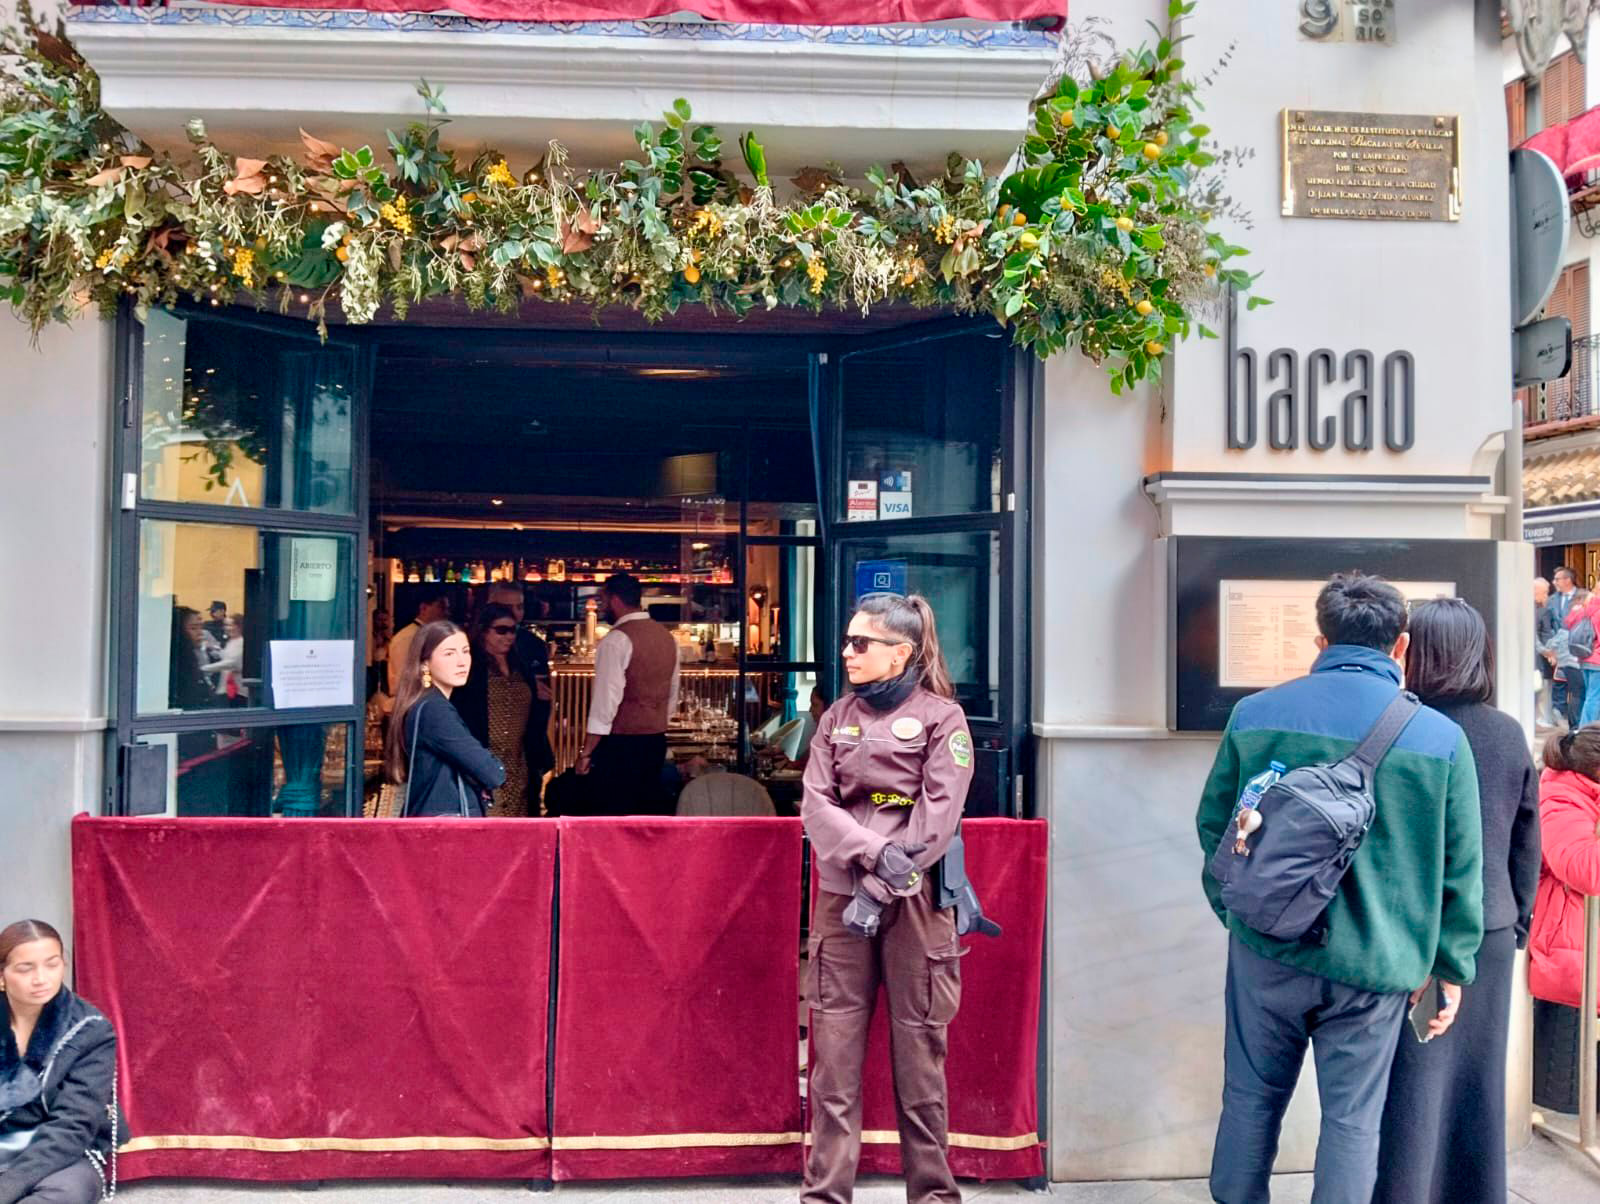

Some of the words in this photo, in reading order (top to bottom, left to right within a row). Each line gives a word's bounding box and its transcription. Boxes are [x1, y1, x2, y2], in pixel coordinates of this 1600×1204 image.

[1310, 138, 1346, 146] ORIGINAL
[1333, 151, 1348, 159] POR
[1348, 179, 1382, 187] ALCALDE
[1408, 180, 1436, 189] CIUDAD
[1318, 190, 1337, 199] JUAN
[1340, 190, 1370, 200] IGNACIO
[1227, 280, 1415, 451] bacao
[884, 503, 910, 513] VISA
[299, 562, 332, 570] ABIERTO
